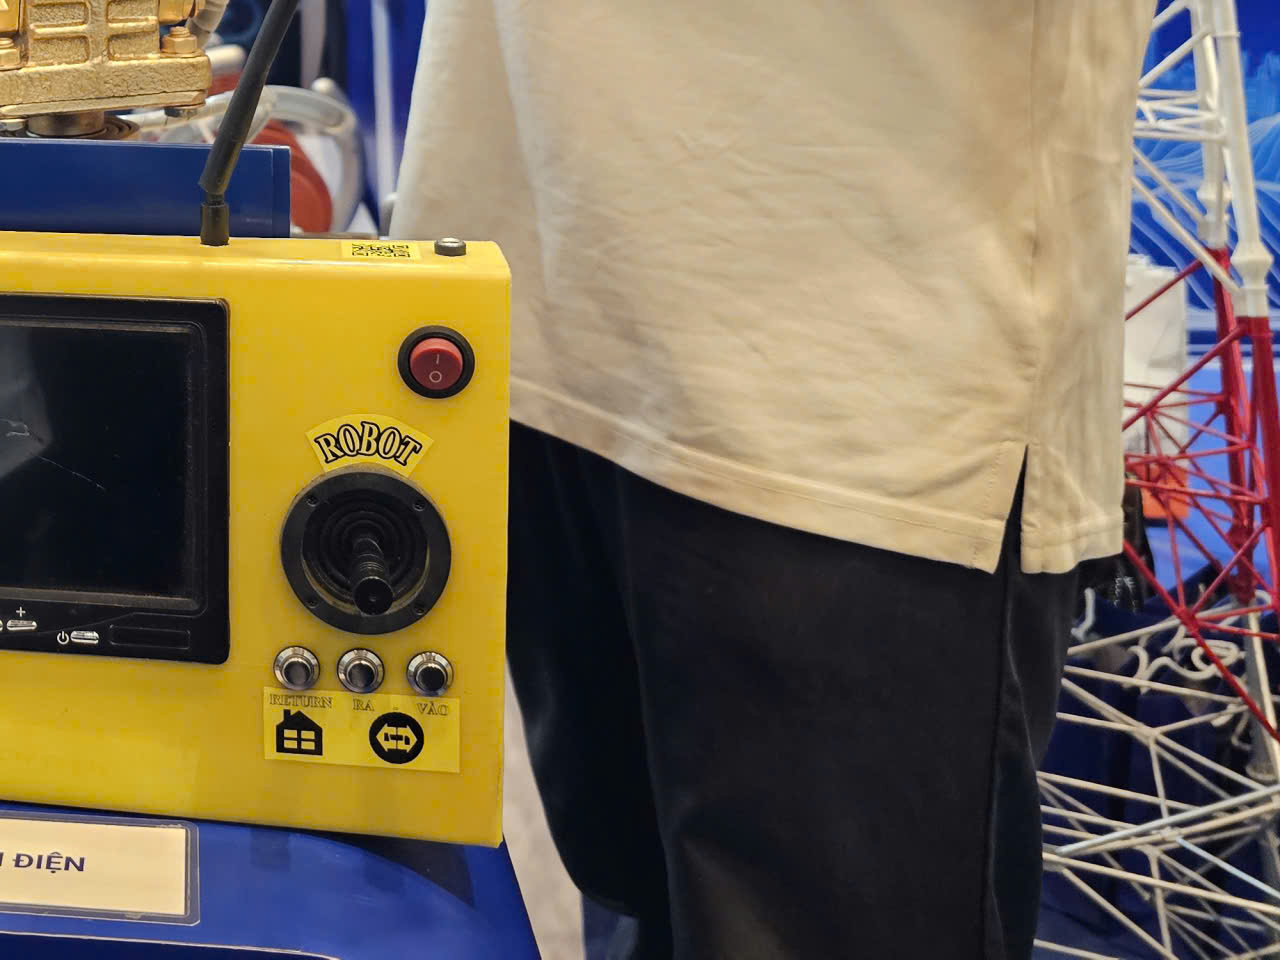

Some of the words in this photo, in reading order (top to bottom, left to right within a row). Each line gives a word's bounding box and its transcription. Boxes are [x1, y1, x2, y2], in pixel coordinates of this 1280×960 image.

[313, 420, 423, 467] ROBOT
[269, 693, 333, 709] RETURN
[353, 698, 375, 712] RA
[13, 851, 86, 874] ĐIỆN
